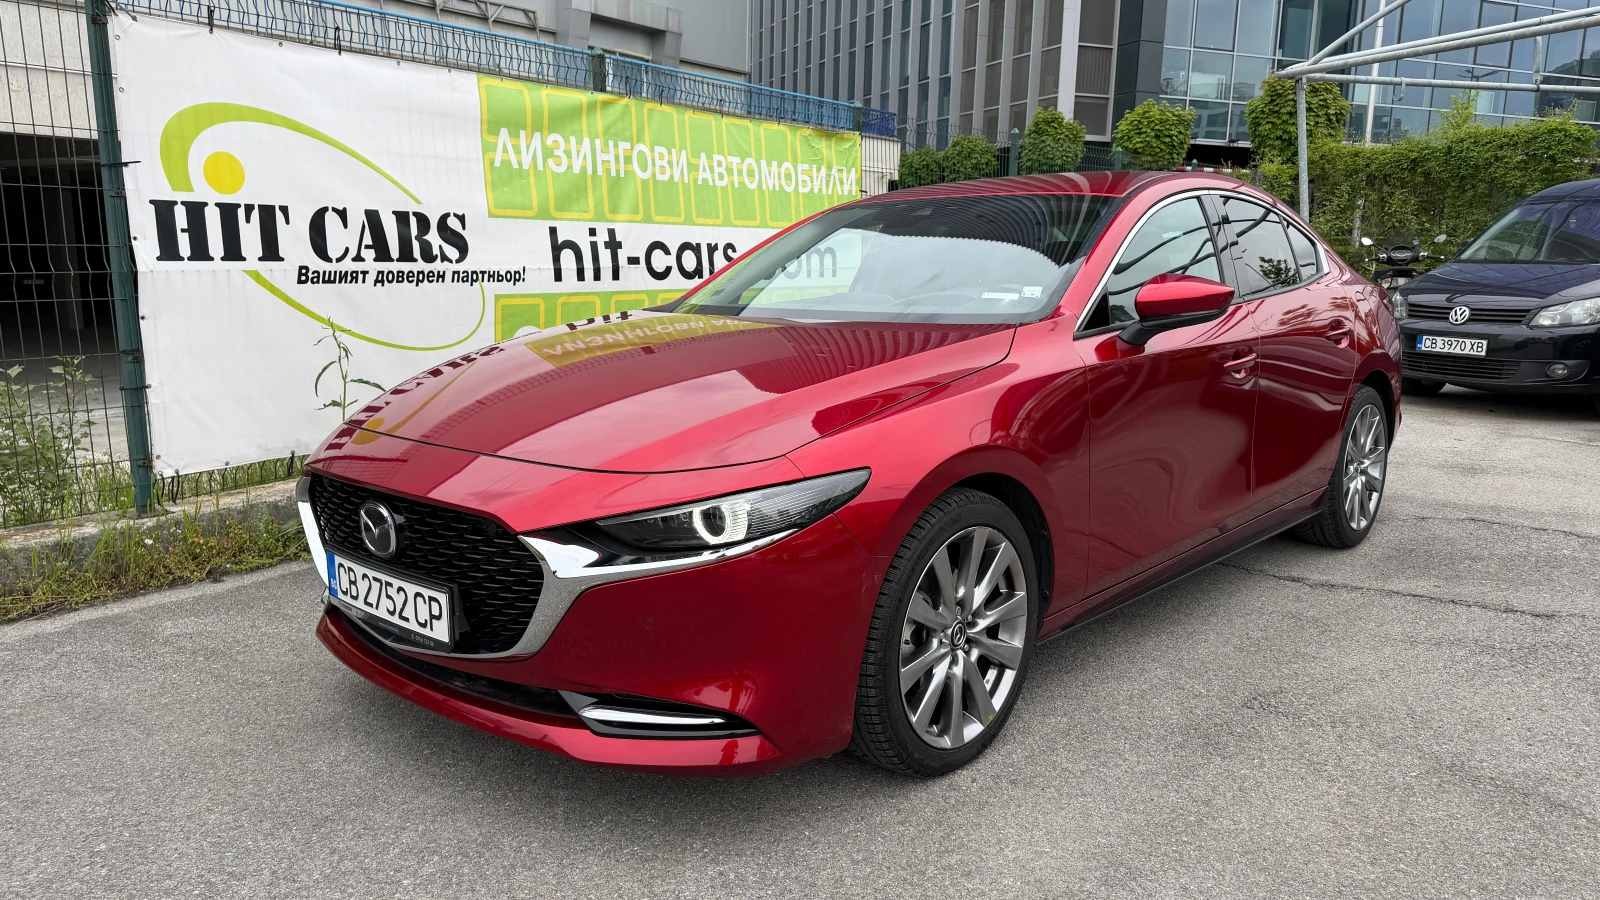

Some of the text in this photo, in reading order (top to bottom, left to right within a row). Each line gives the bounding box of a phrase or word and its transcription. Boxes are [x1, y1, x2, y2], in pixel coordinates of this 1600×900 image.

[494, 127, 857, 196] ЛИЗИНГОВИ АВТОМОБИЛИ
[149, 199, 469, 264] HIT CARS
[297, 265, 526, 287] Вашият доверен партньор!
[1423, 337, 1484, 353] CB 3970 XB
[337, 562, 443, 632] CB 2752 CP
